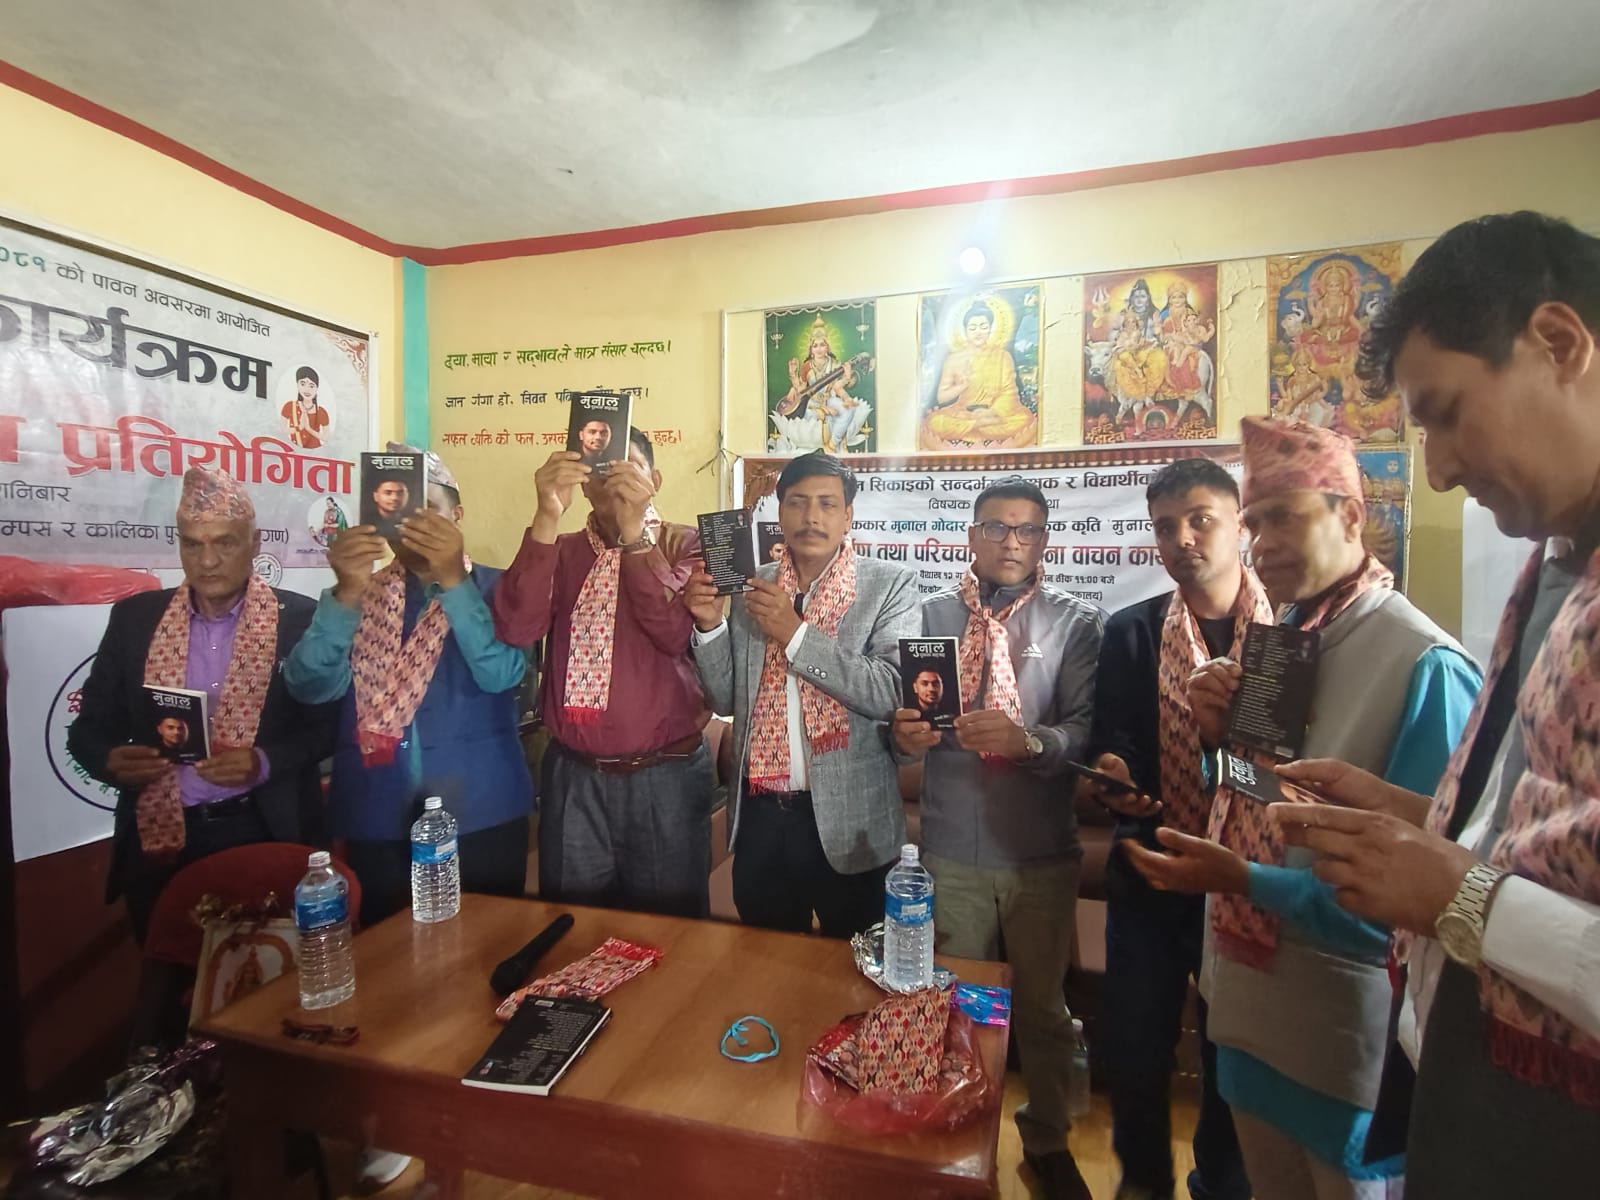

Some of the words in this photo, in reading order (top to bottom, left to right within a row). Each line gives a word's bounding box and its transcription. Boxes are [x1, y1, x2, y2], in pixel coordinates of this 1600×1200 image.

[55, 261, 84, 284] को
[93, 272, 137, 298] पावन
[144, 287, 211, 321] अवसरमा
[216, 311, 271, 338] आयोजित
[472, 352, 498, 367] माया
[601, 341, 628, 357] संसार
[471, 393, 494, 406] गंगा
[580, 395, 620, 409] मुनाल
[57, 414, 356, 495] प्रतियोगिता
[371, 455, 415, 470] मुनाल
[869, 475, 935, 493] सिकाइको
[1065, 477, 1078, 489] र
[928, 497, 971, 510] विषयक
[61, 522, 77, 538] र
[84, 520, 160, 540] कालिका
[890, 520, 927, 533] मुनाल
[931, 517, 967, 532] गोदार
[1071, 516, 1102, 535] कृति
[876, 543, 909, 562] तथा
[1072, 546, 1123, 566] वाचन
[1056, 573, 1073, 584] ठीक
[908, 642, 945, 658] मुनाल
[152, 691, 191, 706] मुनाल
